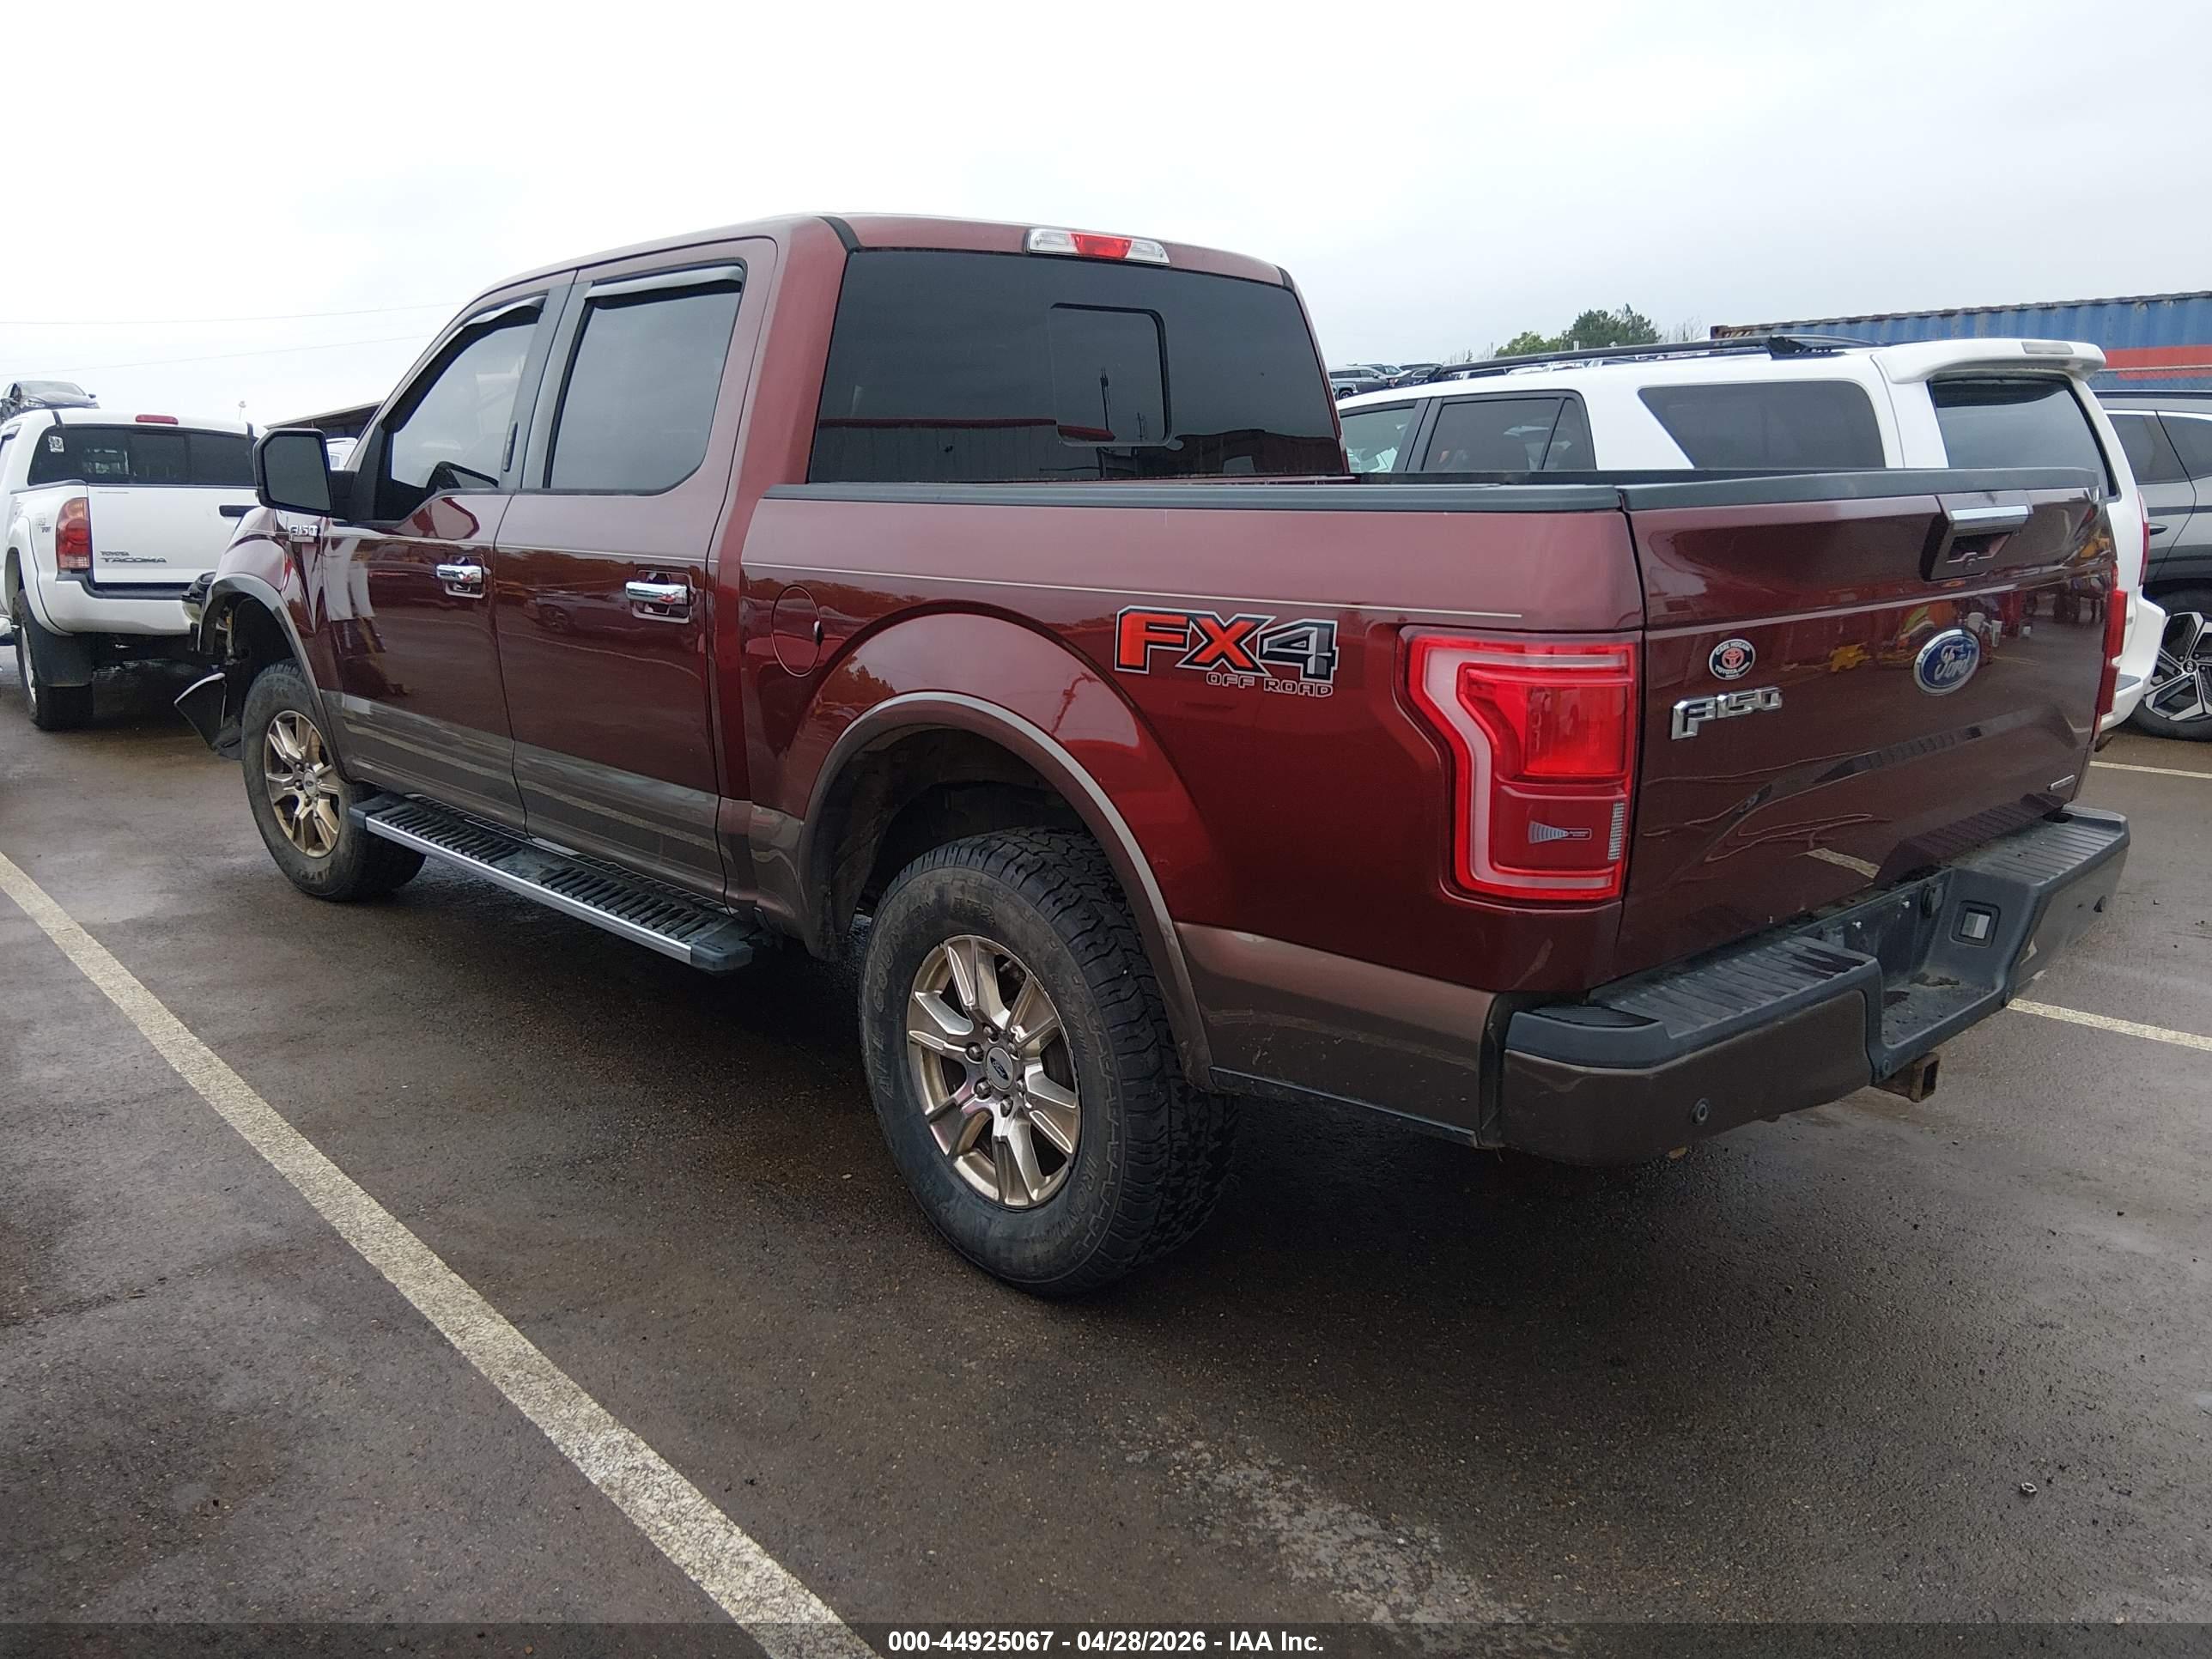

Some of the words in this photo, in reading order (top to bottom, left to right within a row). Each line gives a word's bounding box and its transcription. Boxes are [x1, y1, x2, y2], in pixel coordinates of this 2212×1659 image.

[1115, 605, 1339, 684] FX4
[1934, 644, 1972, 681] Ford
[1206, 672, 1255, 689] OFF
[1263, 677, 1334, 698] ROAD
